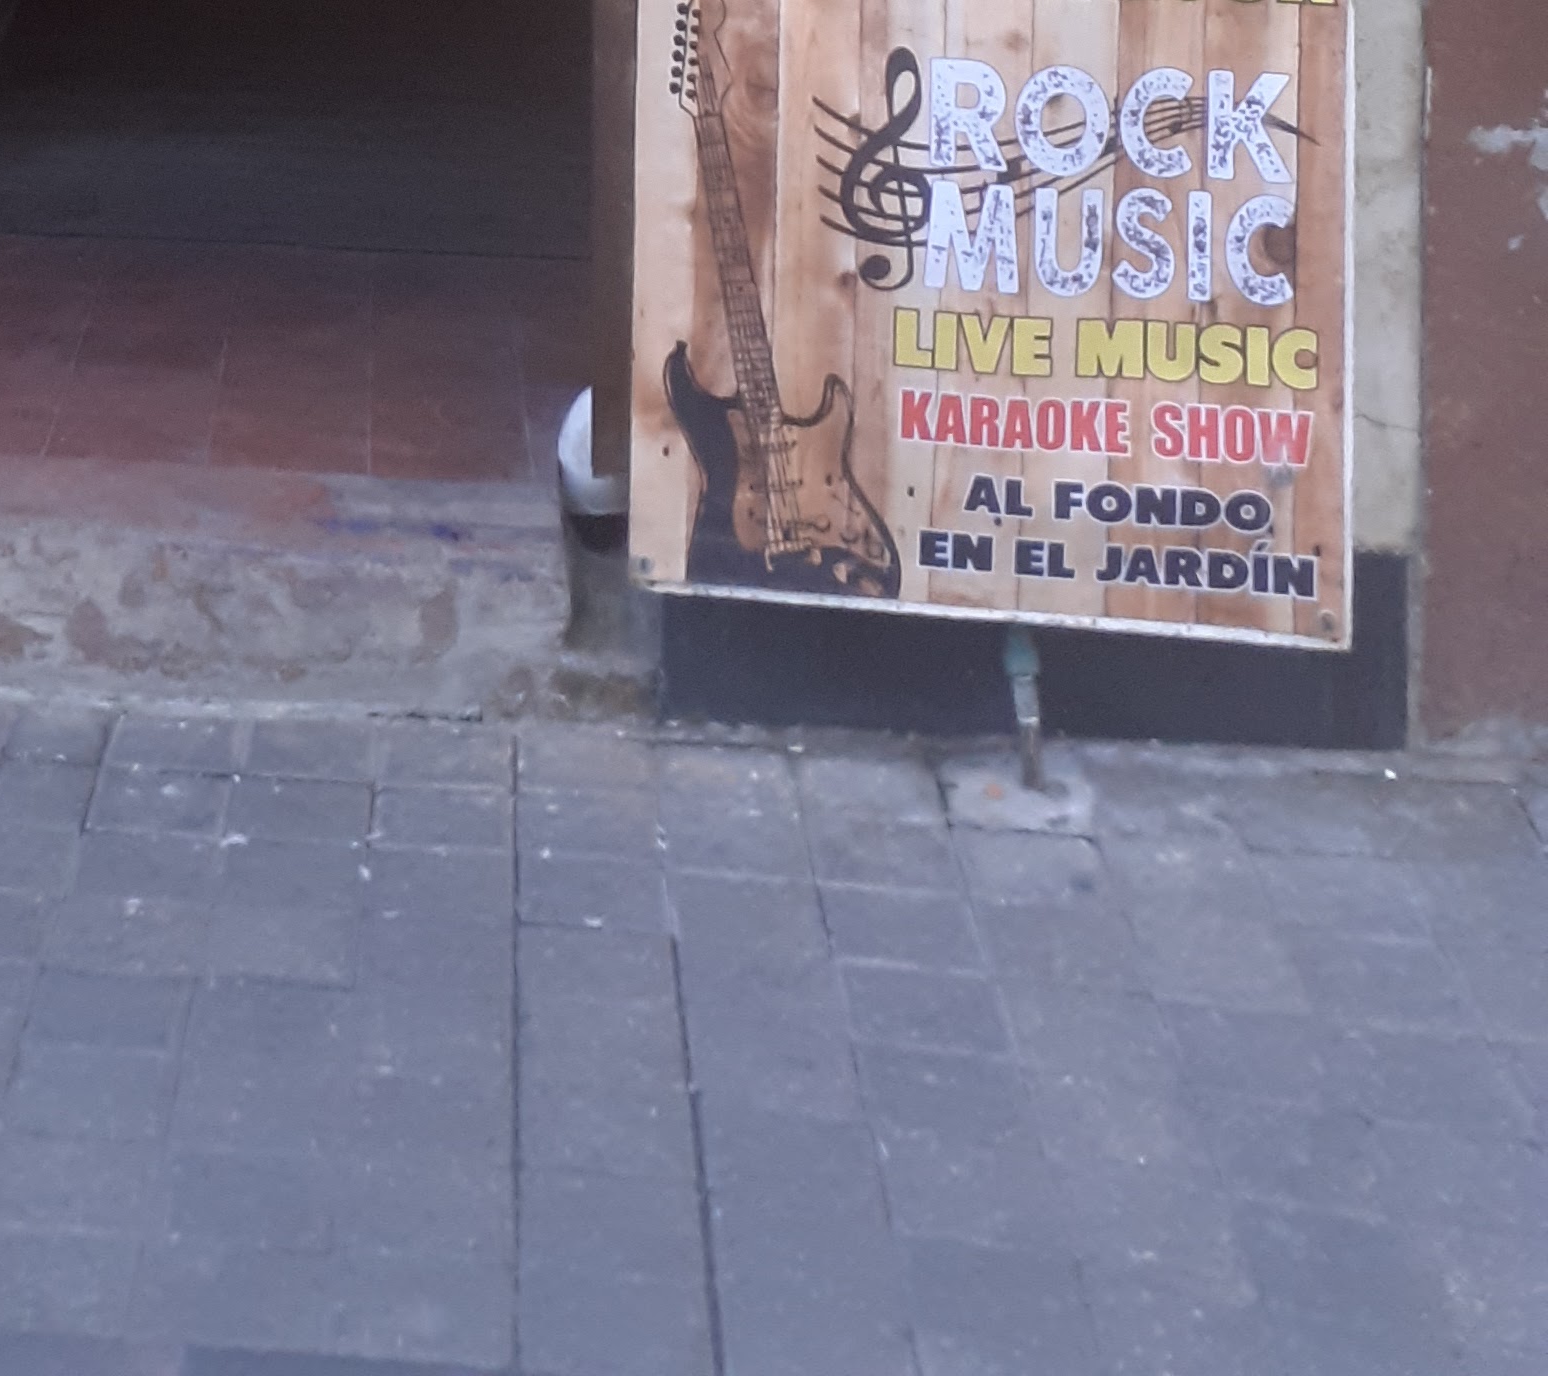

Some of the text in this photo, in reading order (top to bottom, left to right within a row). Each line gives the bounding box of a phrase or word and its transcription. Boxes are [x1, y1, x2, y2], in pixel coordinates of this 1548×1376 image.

[928, 57, 1293, 184] ROCK
[923, 177, 1296, 307] MUSIC
[893, 307, 1319, 390] LIVE MUSIC
[898, 390, 1313, 467] KARAOKE SHOW
[964, 472, 1272, 534] AL FONDO
[918, 528, 1319, 601] EN EL JARDÍN
